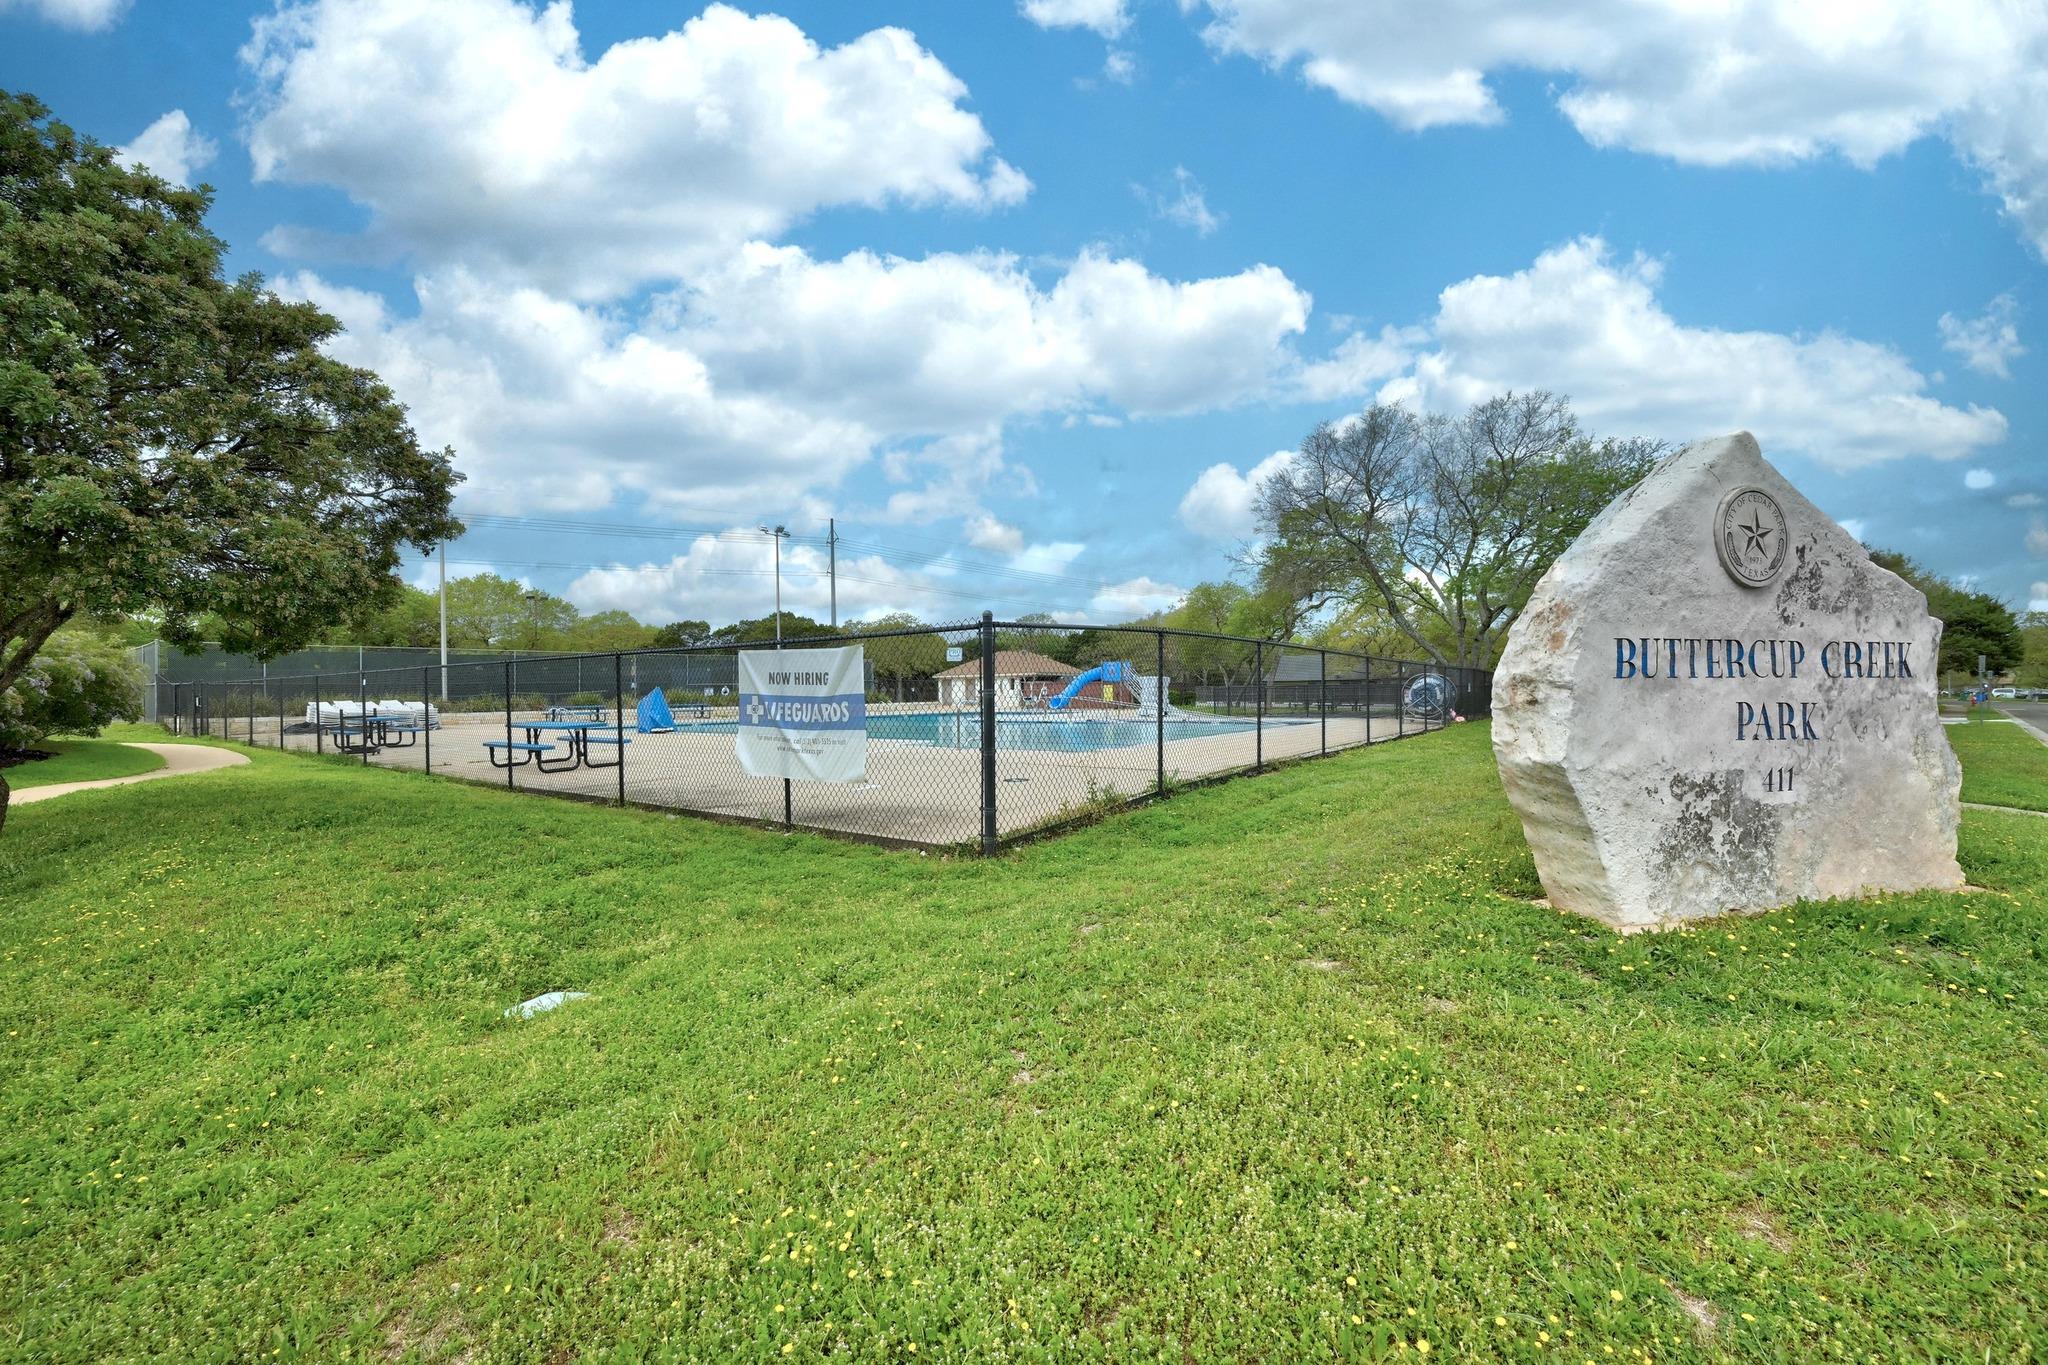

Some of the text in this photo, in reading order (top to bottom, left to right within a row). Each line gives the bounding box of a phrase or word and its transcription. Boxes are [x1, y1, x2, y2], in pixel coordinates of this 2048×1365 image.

[1726, 494, 1785, 534] CITY OF CEDAR PARK
[1743, 566, 1769, 578] TEXAS
[1613, 637, 1913, 679] BUTTERCUP CREEK
[768, 671, 830, 686] NOW HIRING
[1736, 701, 1819, 741] PARK
[1762, 766, 1794, 792] 411
